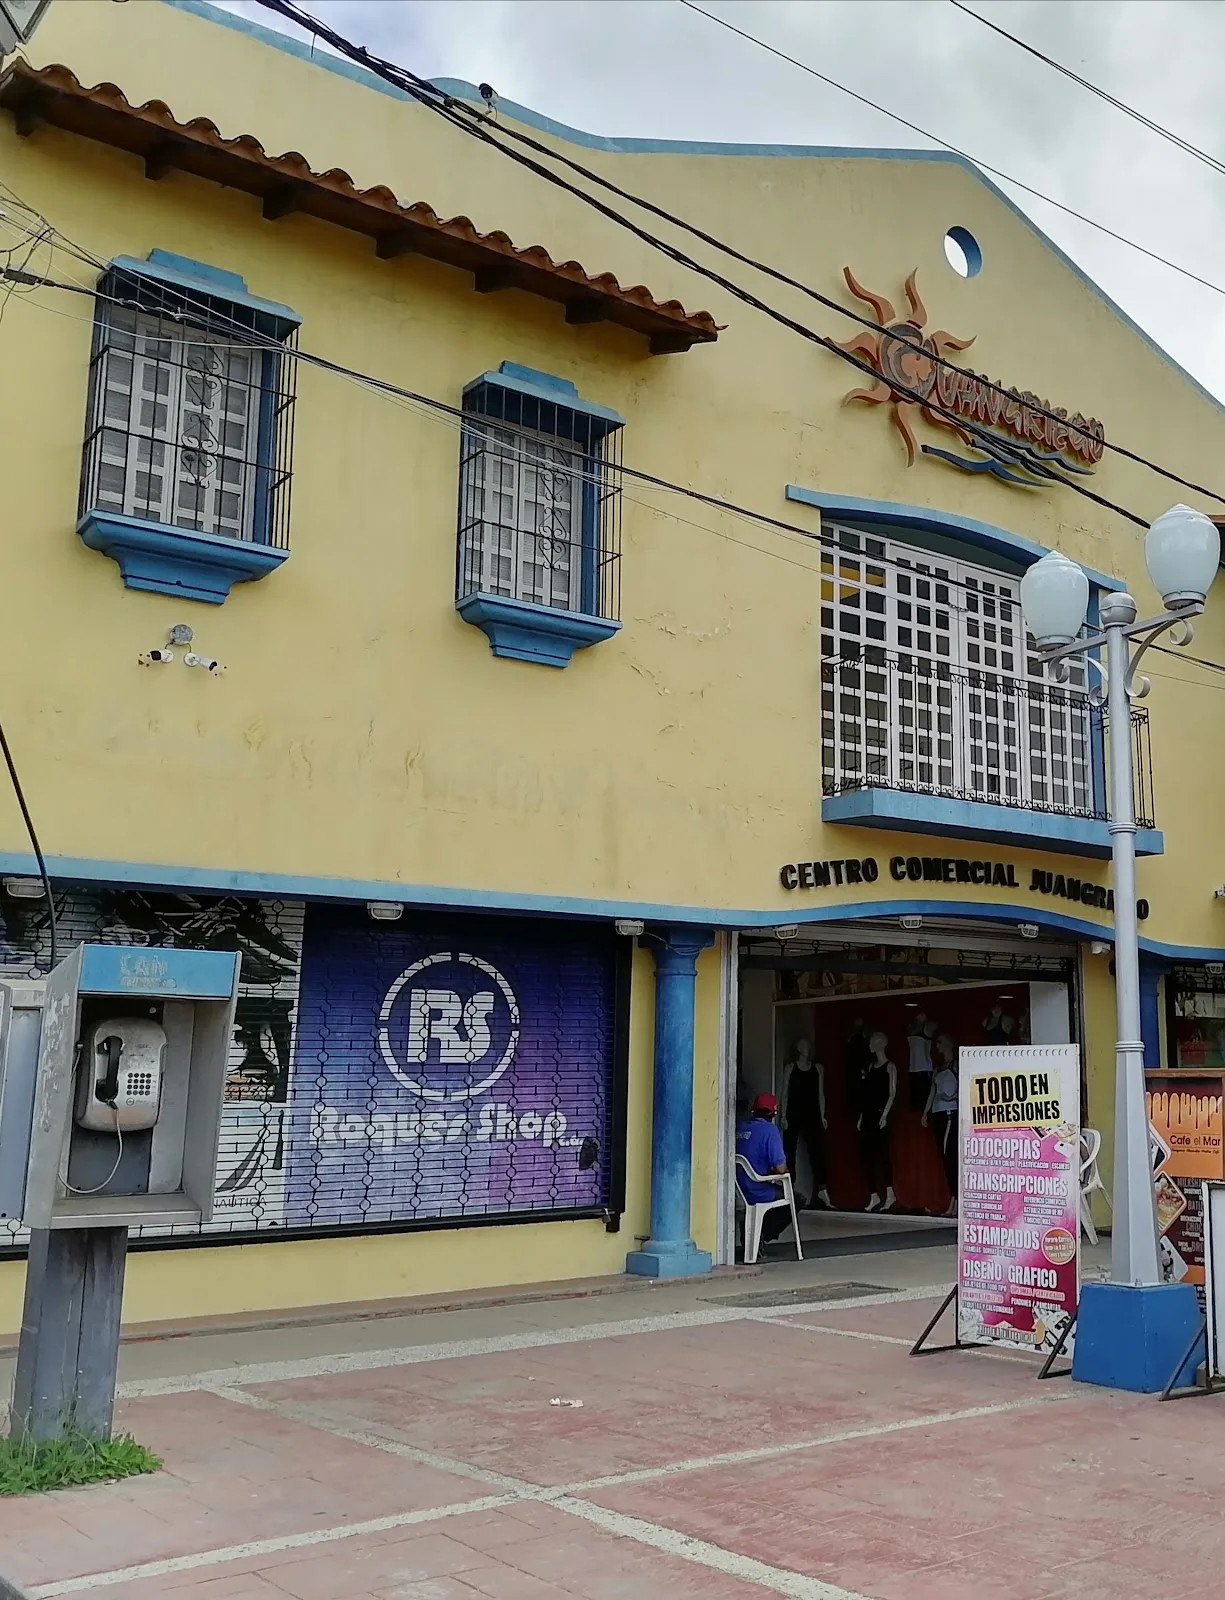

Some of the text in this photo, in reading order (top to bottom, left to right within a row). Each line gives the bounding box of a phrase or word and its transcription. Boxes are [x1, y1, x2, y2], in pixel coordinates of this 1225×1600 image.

[780, 856, 1149, 920] CENTRO COMERCIAL JUANGRIO
[407, 989, 494, 1063] RS
[975, 1073, 1049, 1105] TODO EN
[476, 1103, 568, 1148] Shop
[972, 1100, 1060, 1125] IMPRESIONES
[963, 1137, 1041, 1160] FOTOCOPIAS
[1170, 1135, 1220, 1146] Cafe el Mar
[963, 1171, 1069, 1197] TRANSCRIPCIONES
[963, 1224, 1040, 1250] ESTAMPADOS
[963, 1258, 1057, 1289] DISEÑO GRAFICO
